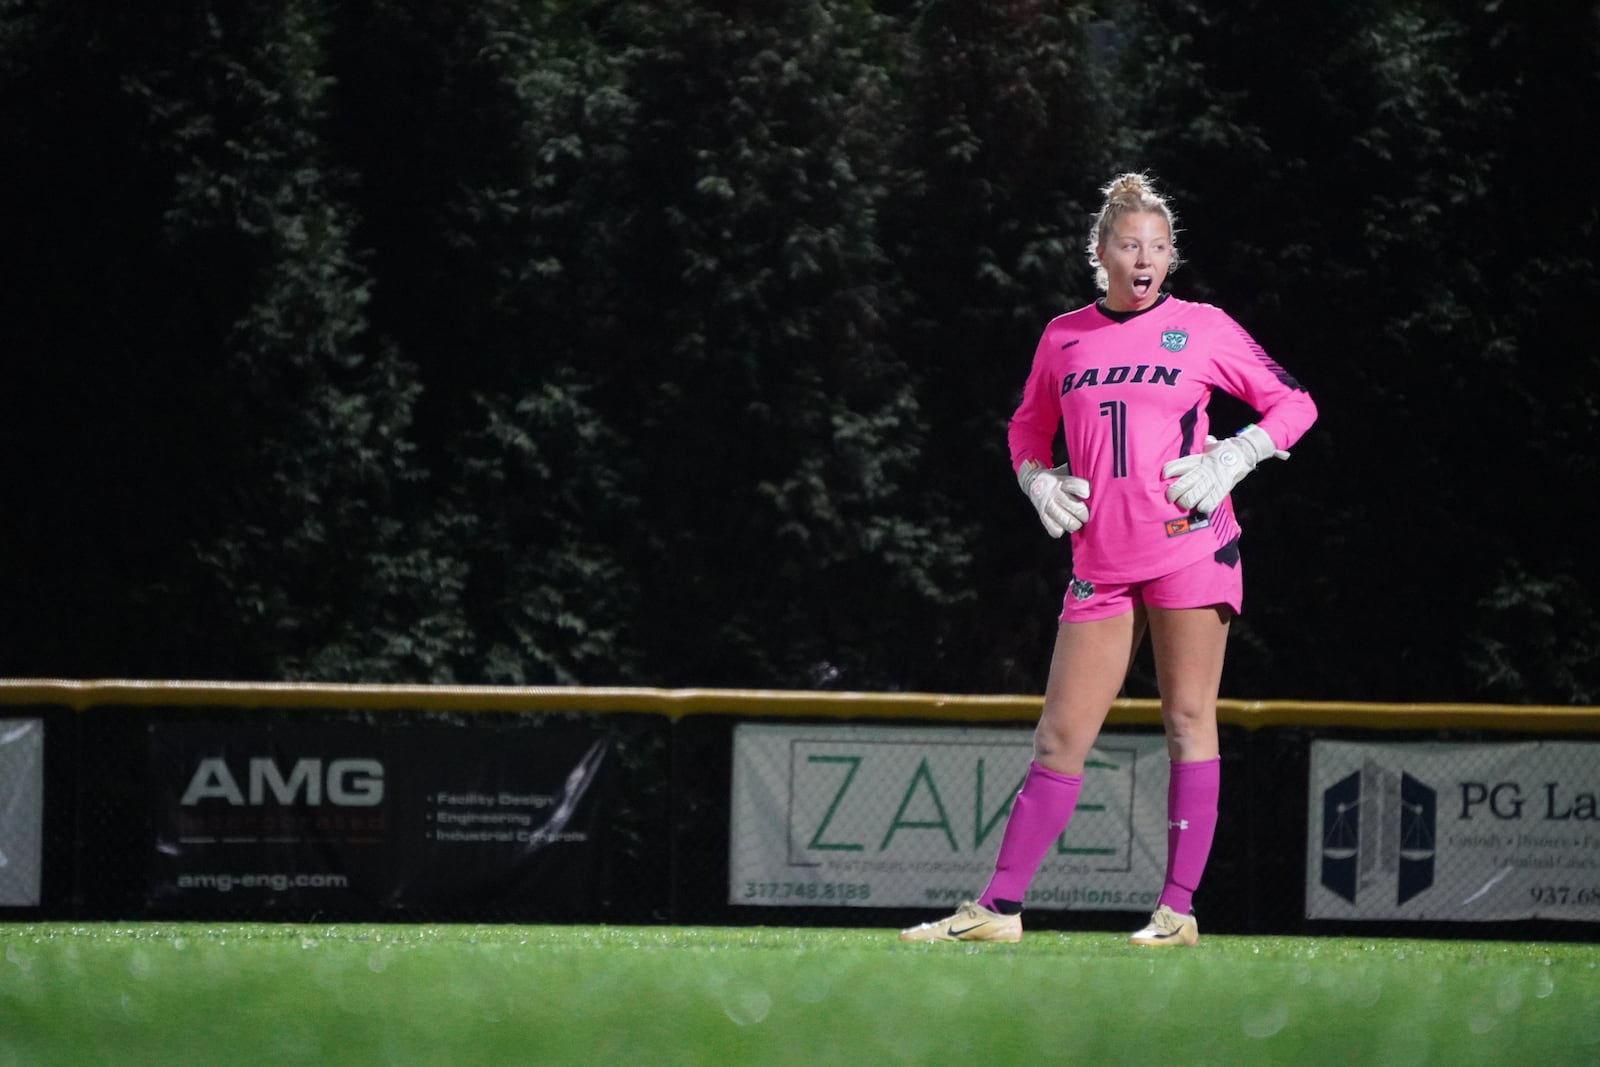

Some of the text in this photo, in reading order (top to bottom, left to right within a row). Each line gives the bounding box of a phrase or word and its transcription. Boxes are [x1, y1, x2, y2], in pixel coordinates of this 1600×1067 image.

[1061, 365, 1182, 397] BADIN
[1100, 400, 1128, 478] 1
[180, 757, 385, 807] AMG
[437, 792, 496, 807] Facility
[1457, 781, 1526, 820] PG
[436, 812, 533, 826] Engineering
[436, 829, 514, 842] Industrial
[176, 873, 349, 892] amg-eng.com
[744, 882, 871, 900] 317.748.8188
